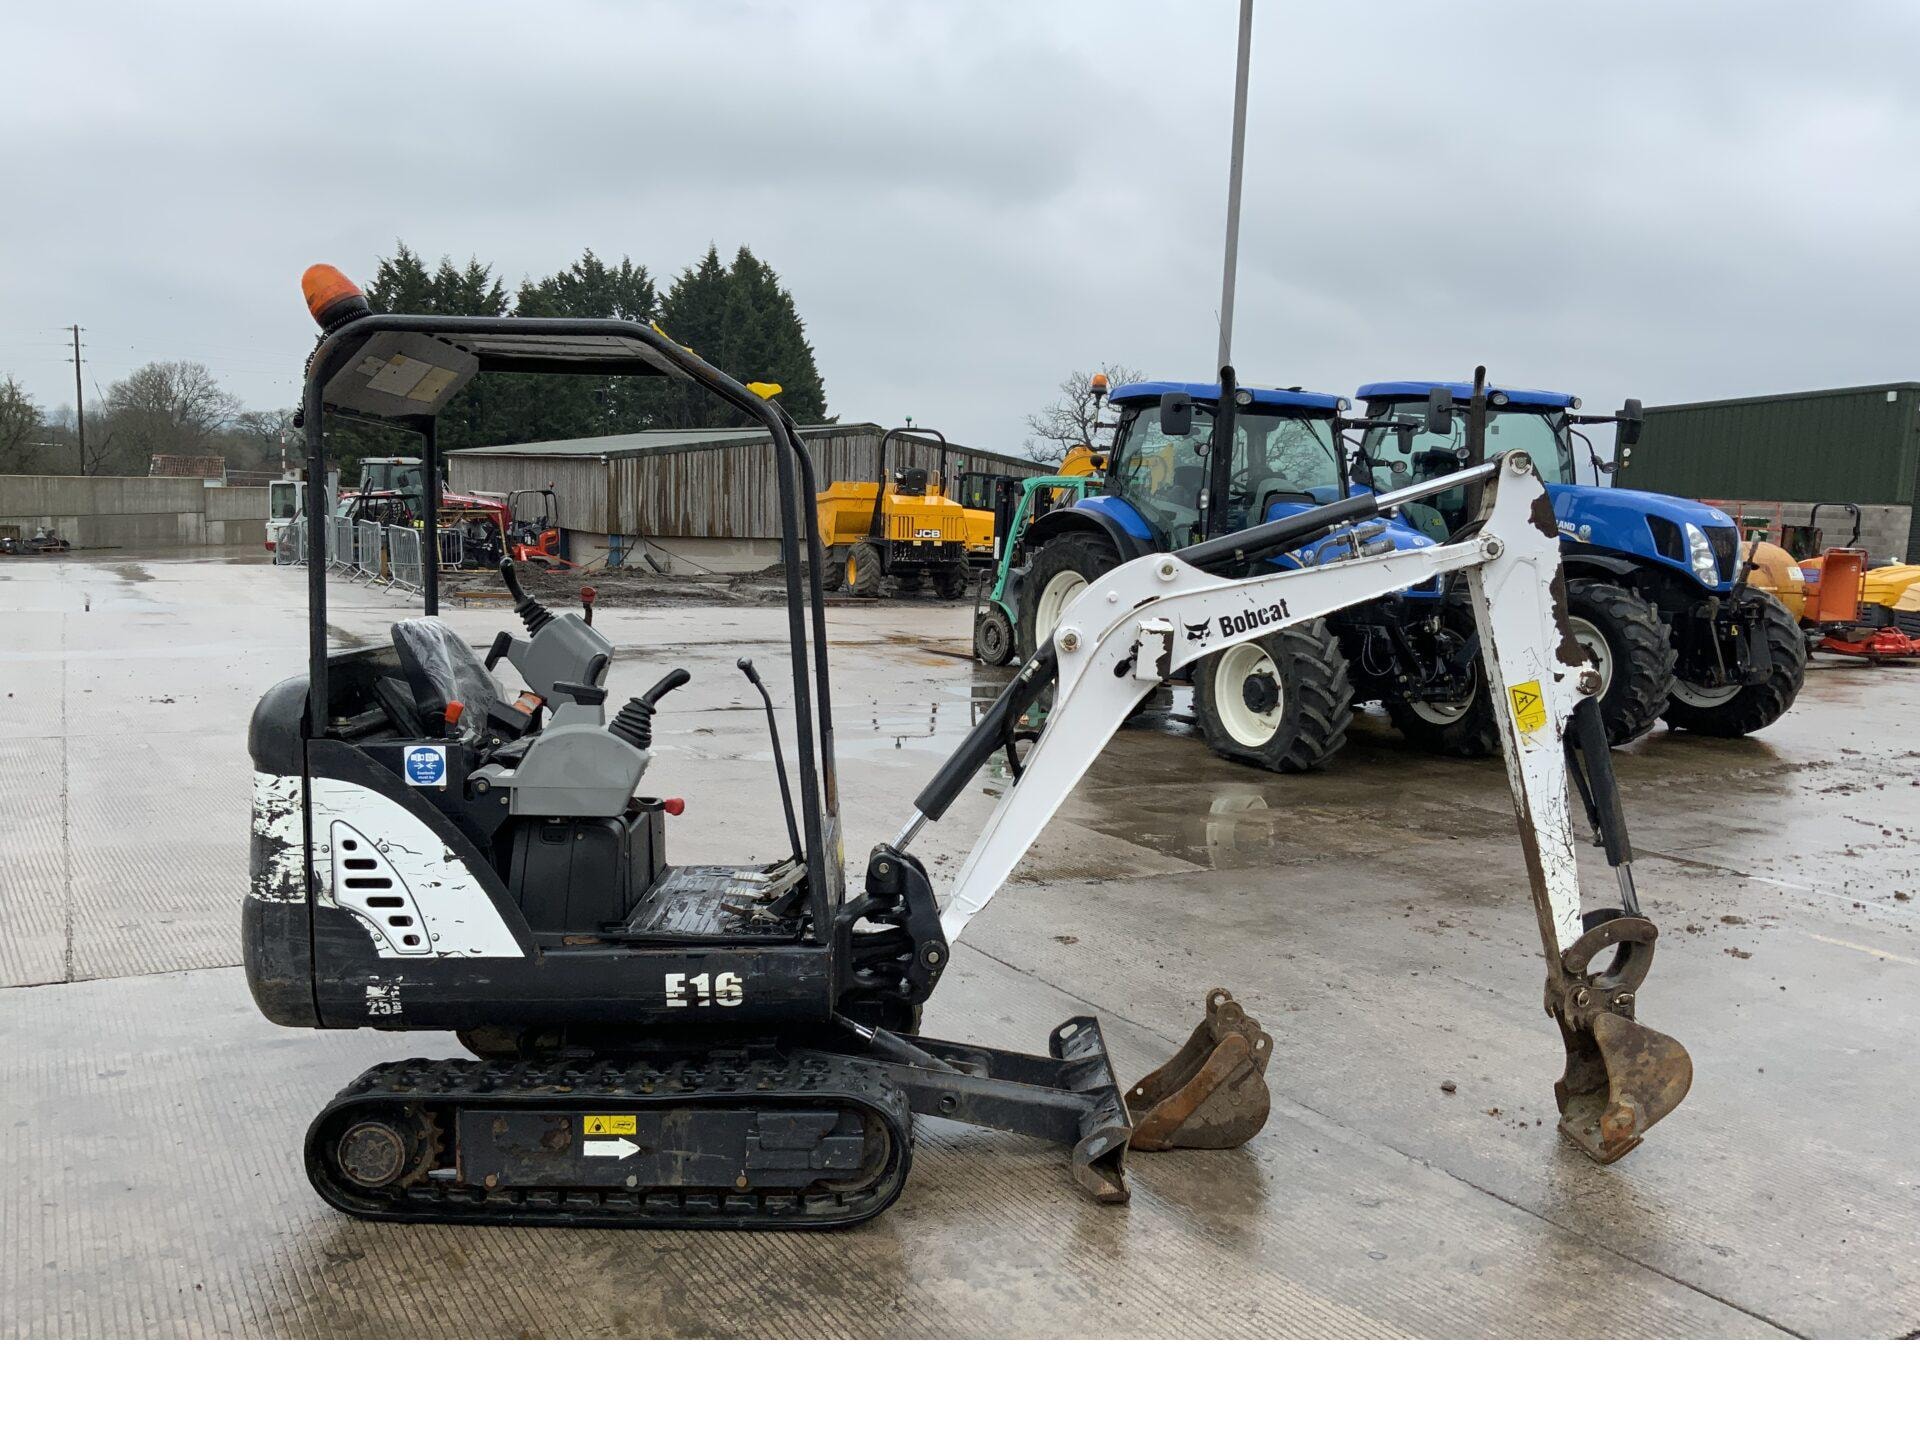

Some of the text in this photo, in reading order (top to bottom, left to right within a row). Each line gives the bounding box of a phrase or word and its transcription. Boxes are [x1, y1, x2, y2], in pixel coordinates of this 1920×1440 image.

[915, 530, 940, 538] JCB
[1218, 598, 1291, 638] Bobcat
[665, 972, 743, 1007] E16
